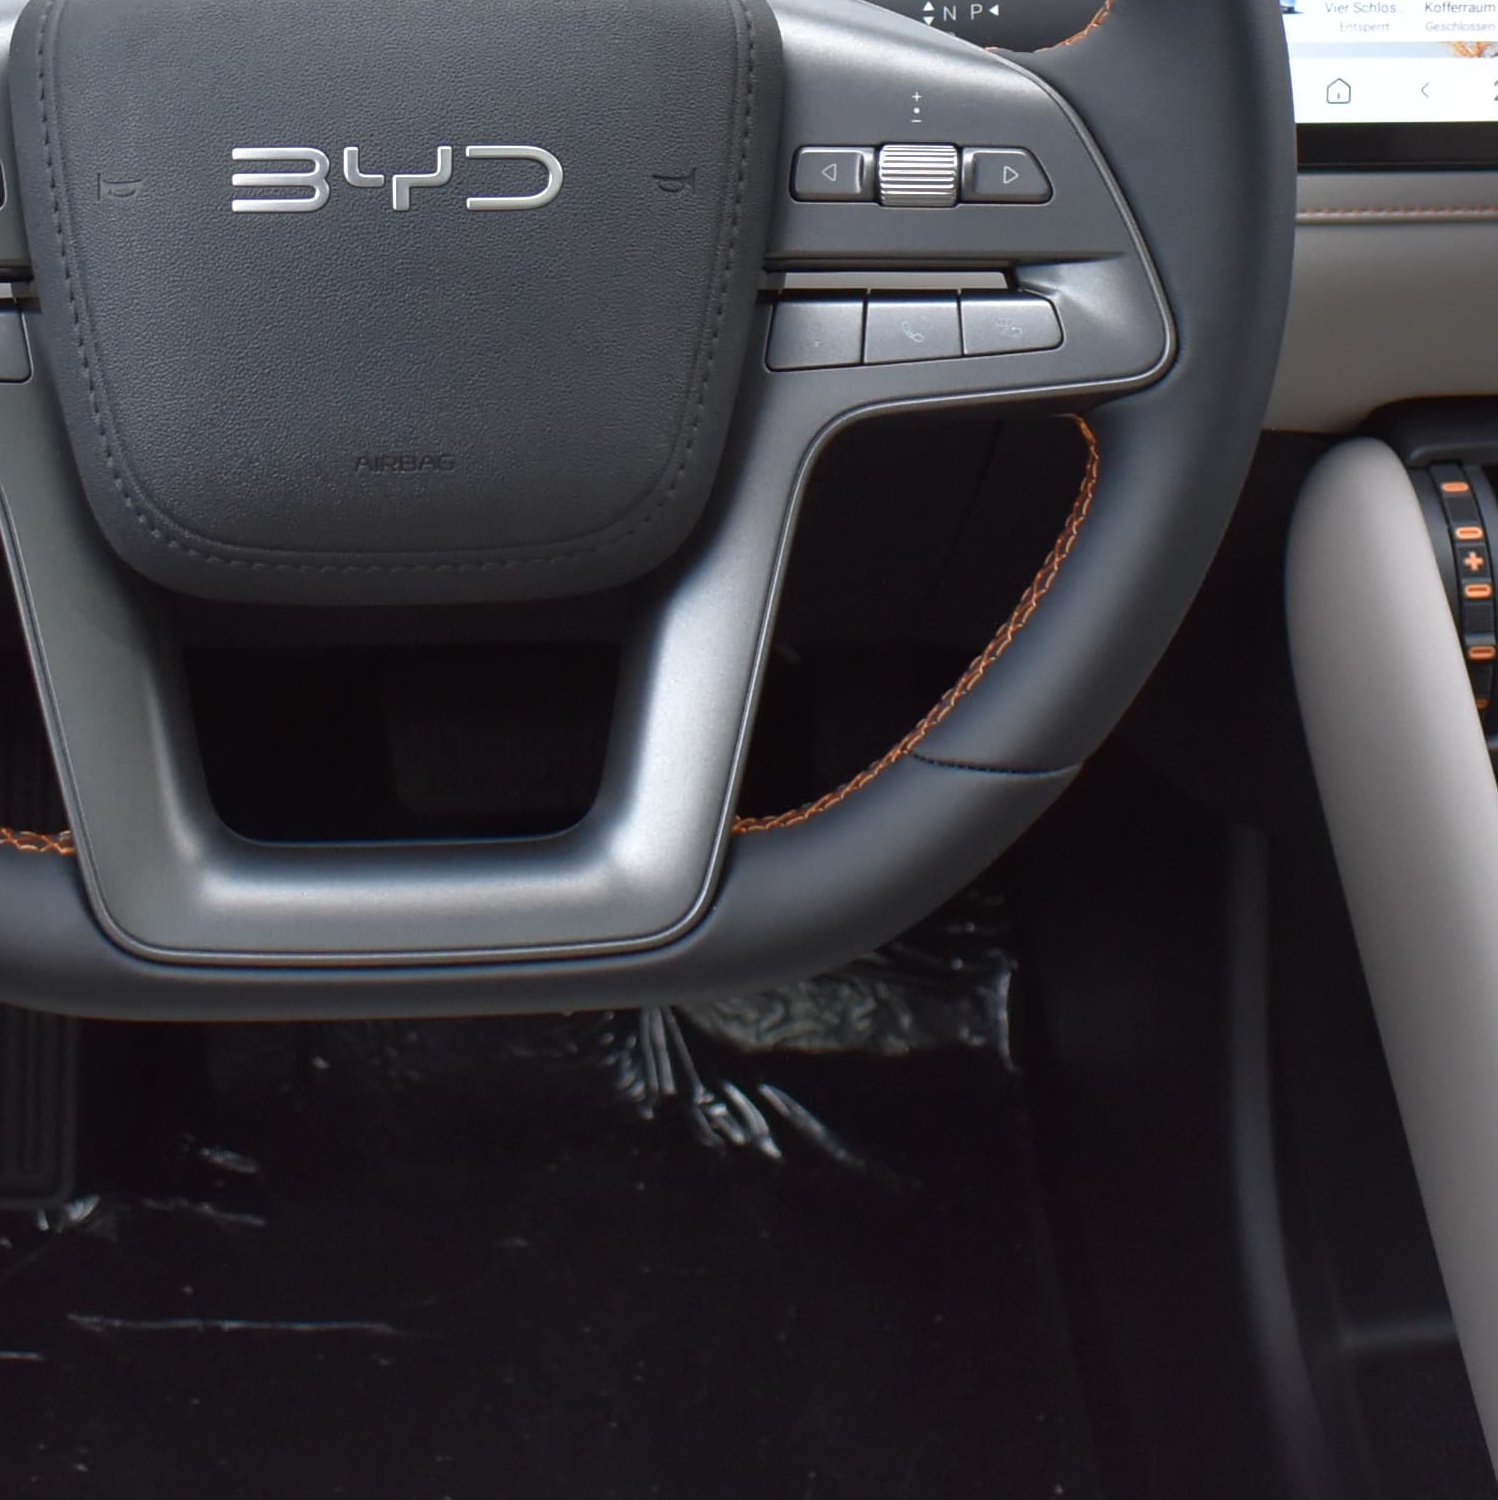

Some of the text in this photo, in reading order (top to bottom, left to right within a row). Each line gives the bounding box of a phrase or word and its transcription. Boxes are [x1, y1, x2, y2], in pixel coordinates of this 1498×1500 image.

[944, 4, 983, 20] N P
[1325, 1, 1349, 13] Vier
[1425, 1, 1497, 13] Kofferraum
[231, 145, 565, 213] BYD
[354, 454, 455, 474] AIRBAG
